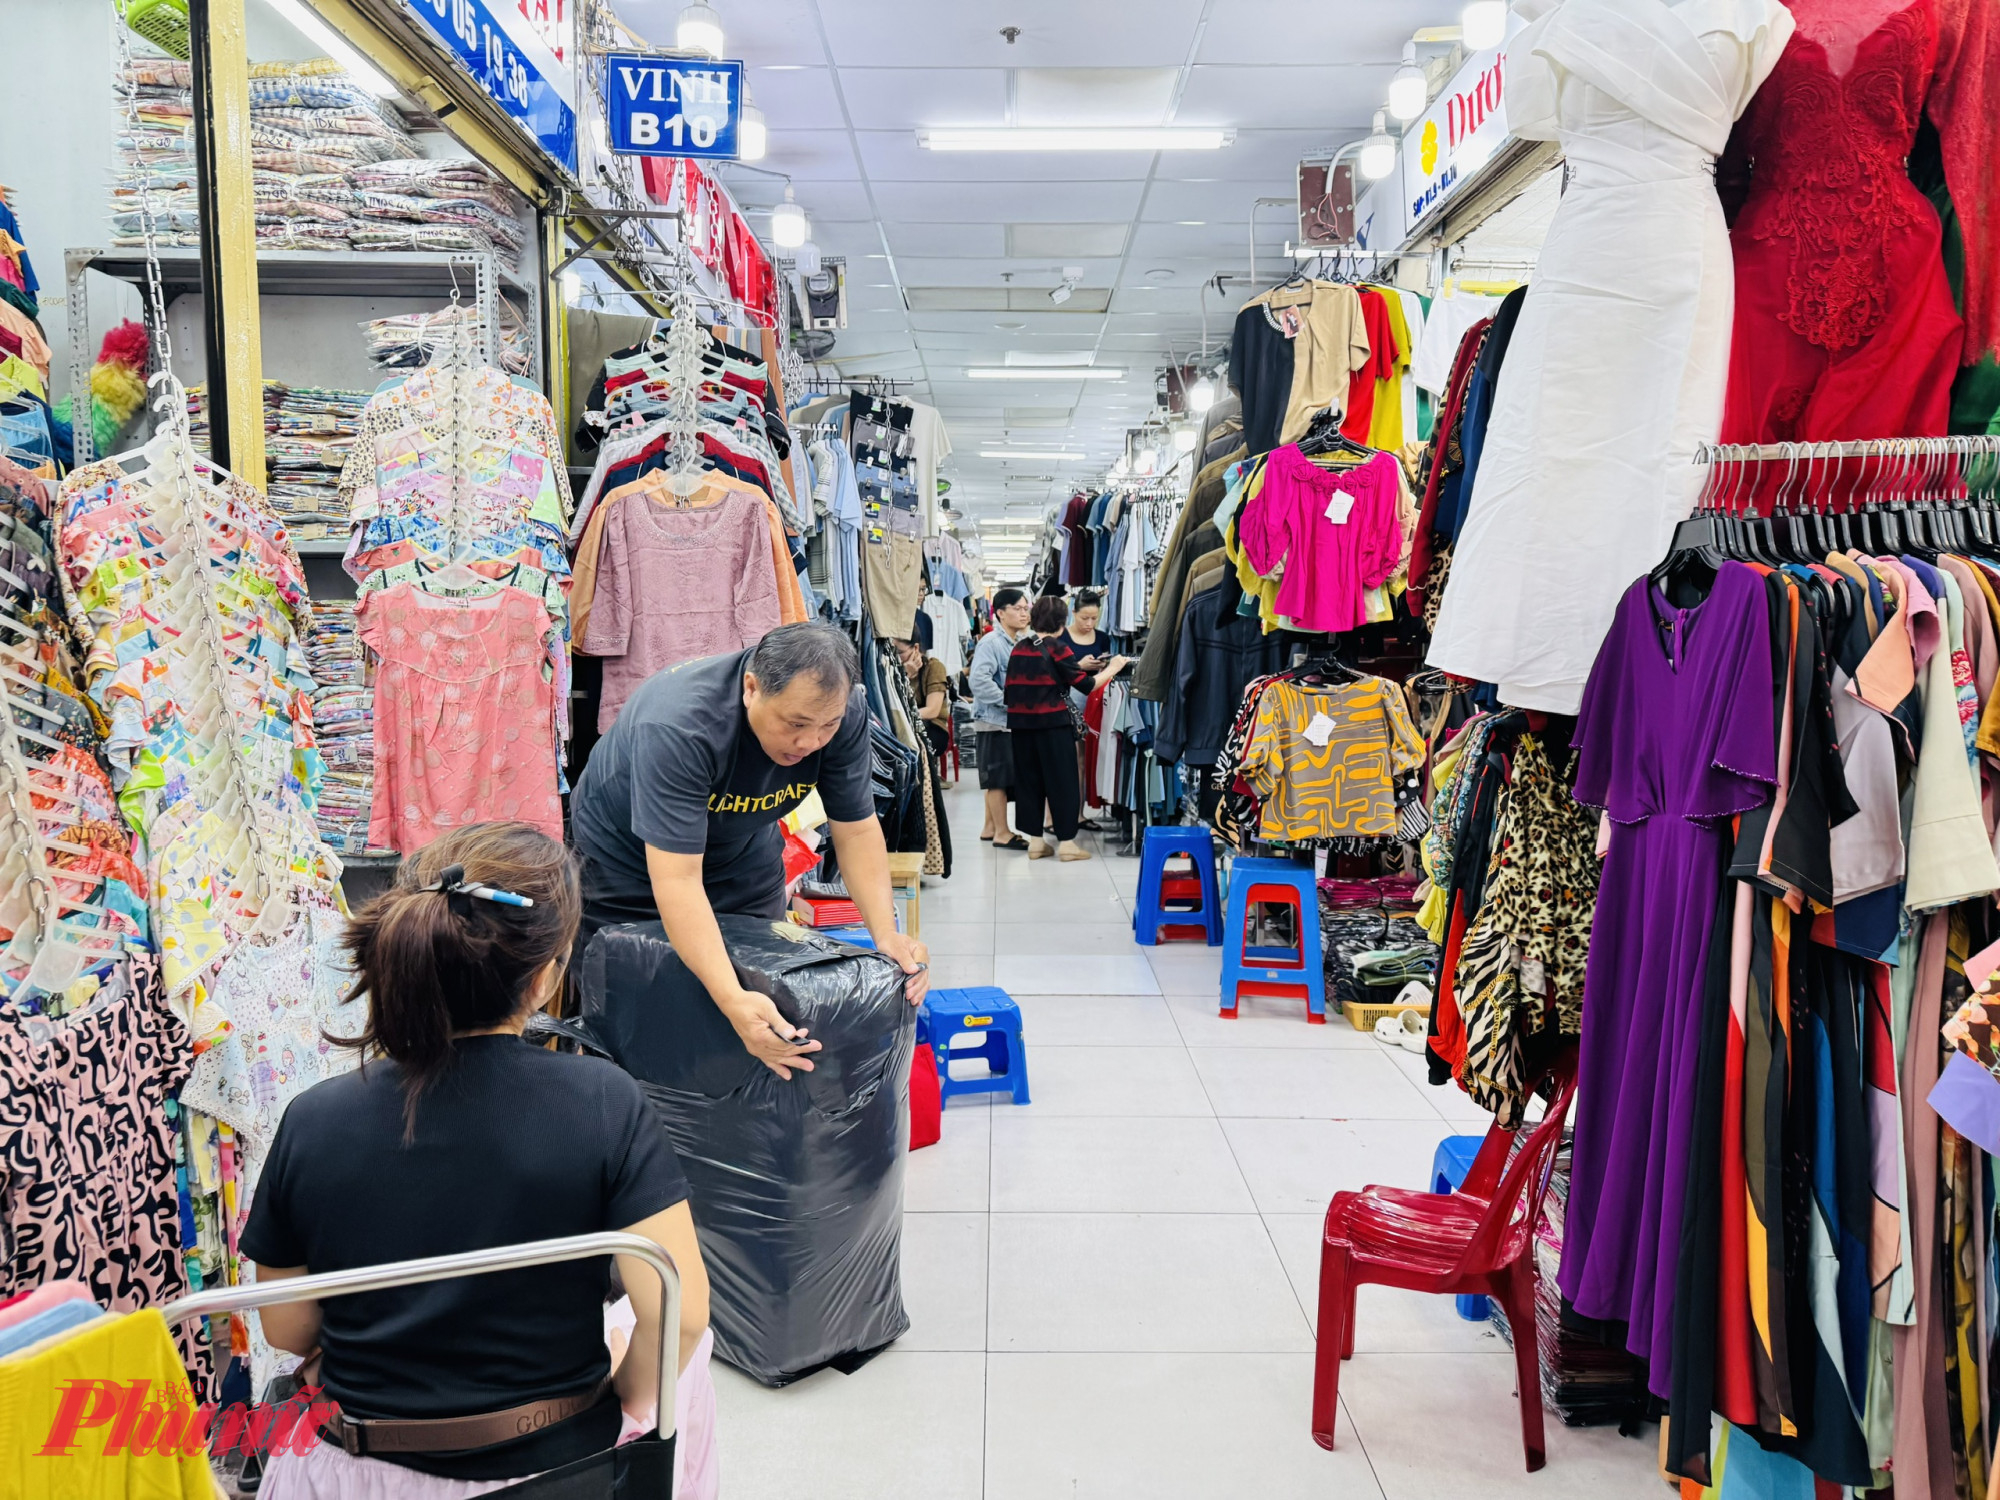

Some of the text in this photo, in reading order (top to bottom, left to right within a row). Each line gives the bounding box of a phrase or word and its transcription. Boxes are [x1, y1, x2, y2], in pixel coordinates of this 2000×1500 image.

[452, 0, 529, 109] 05 19 38
[618, 66, 732, 104] VINH
[630, 112, 717, 148] B10
[1446, 52, 1507, 157] Dươ
